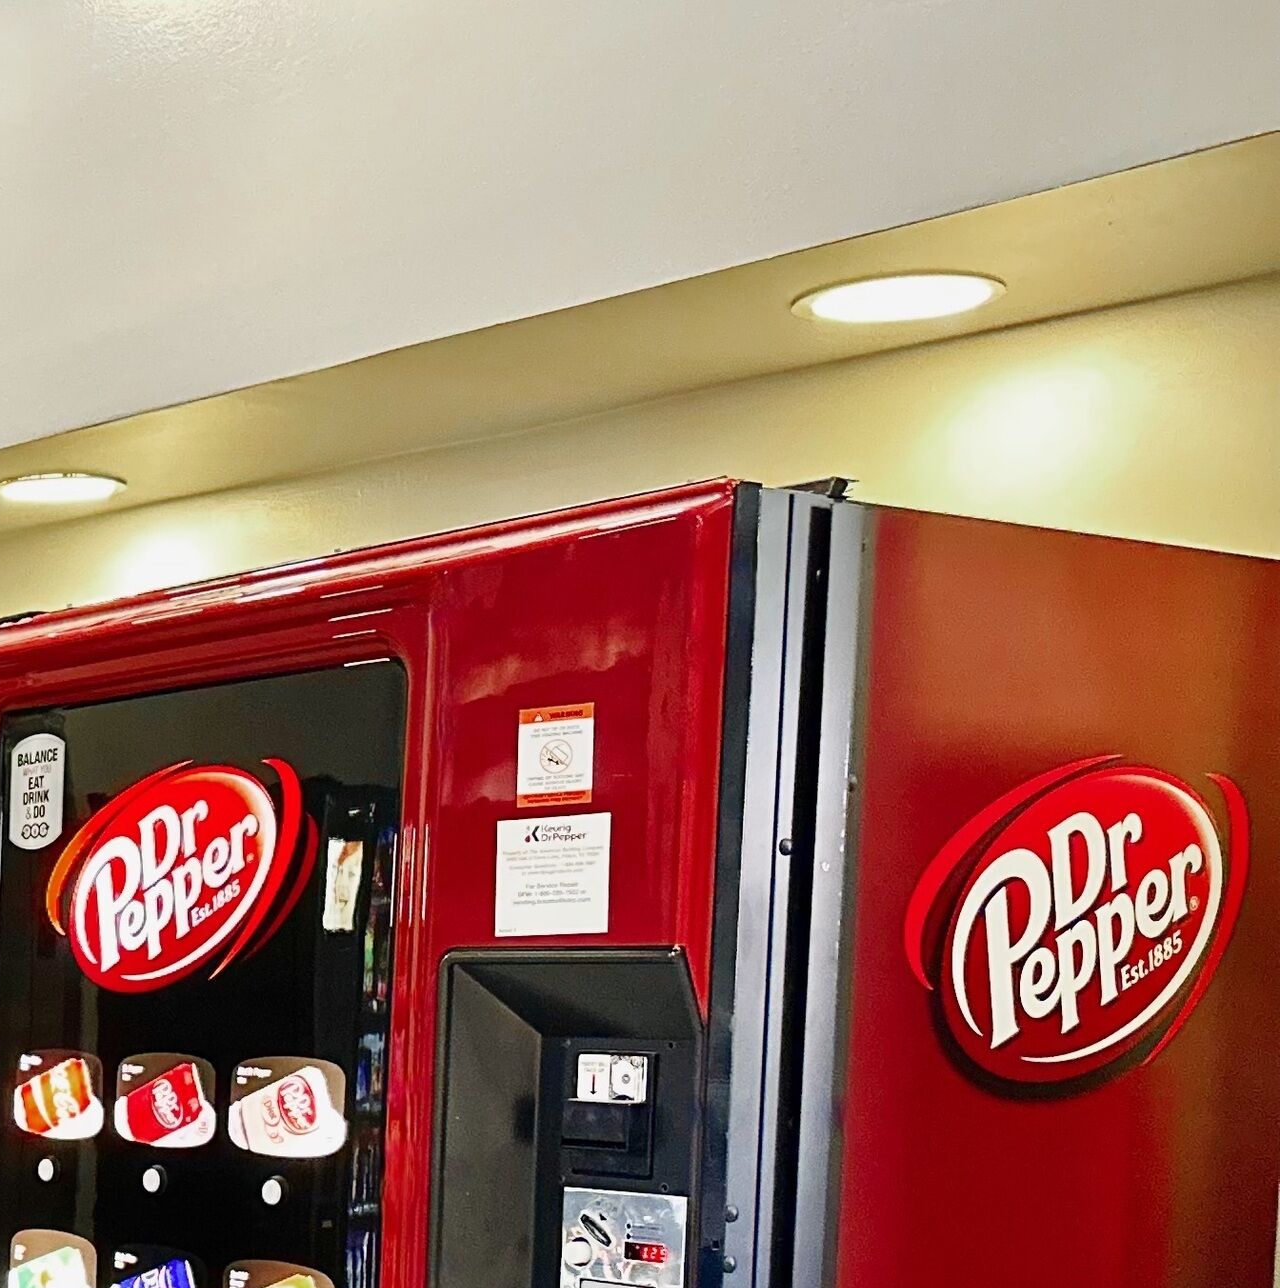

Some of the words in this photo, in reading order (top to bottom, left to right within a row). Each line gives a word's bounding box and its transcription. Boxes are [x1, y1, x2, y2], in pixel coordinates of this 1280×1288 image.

[17, 748, 58, 767] BALANCE
[28, 775, 45, 790] EAT
[23, 789, 49, 806] DRINK
[33, 804, 45, 818] DO
[541, 825, 572, 833] Keurig
[541, 833, 552, 842] Dr
[552, 832, 587, 842] Pepper
[139, 800, 208, 890] Dr
[1047, 811, 1142, 932] Dr
[82, 813, 260, 972] Pepper
[960, 842, 1203, 1050] Pepper
